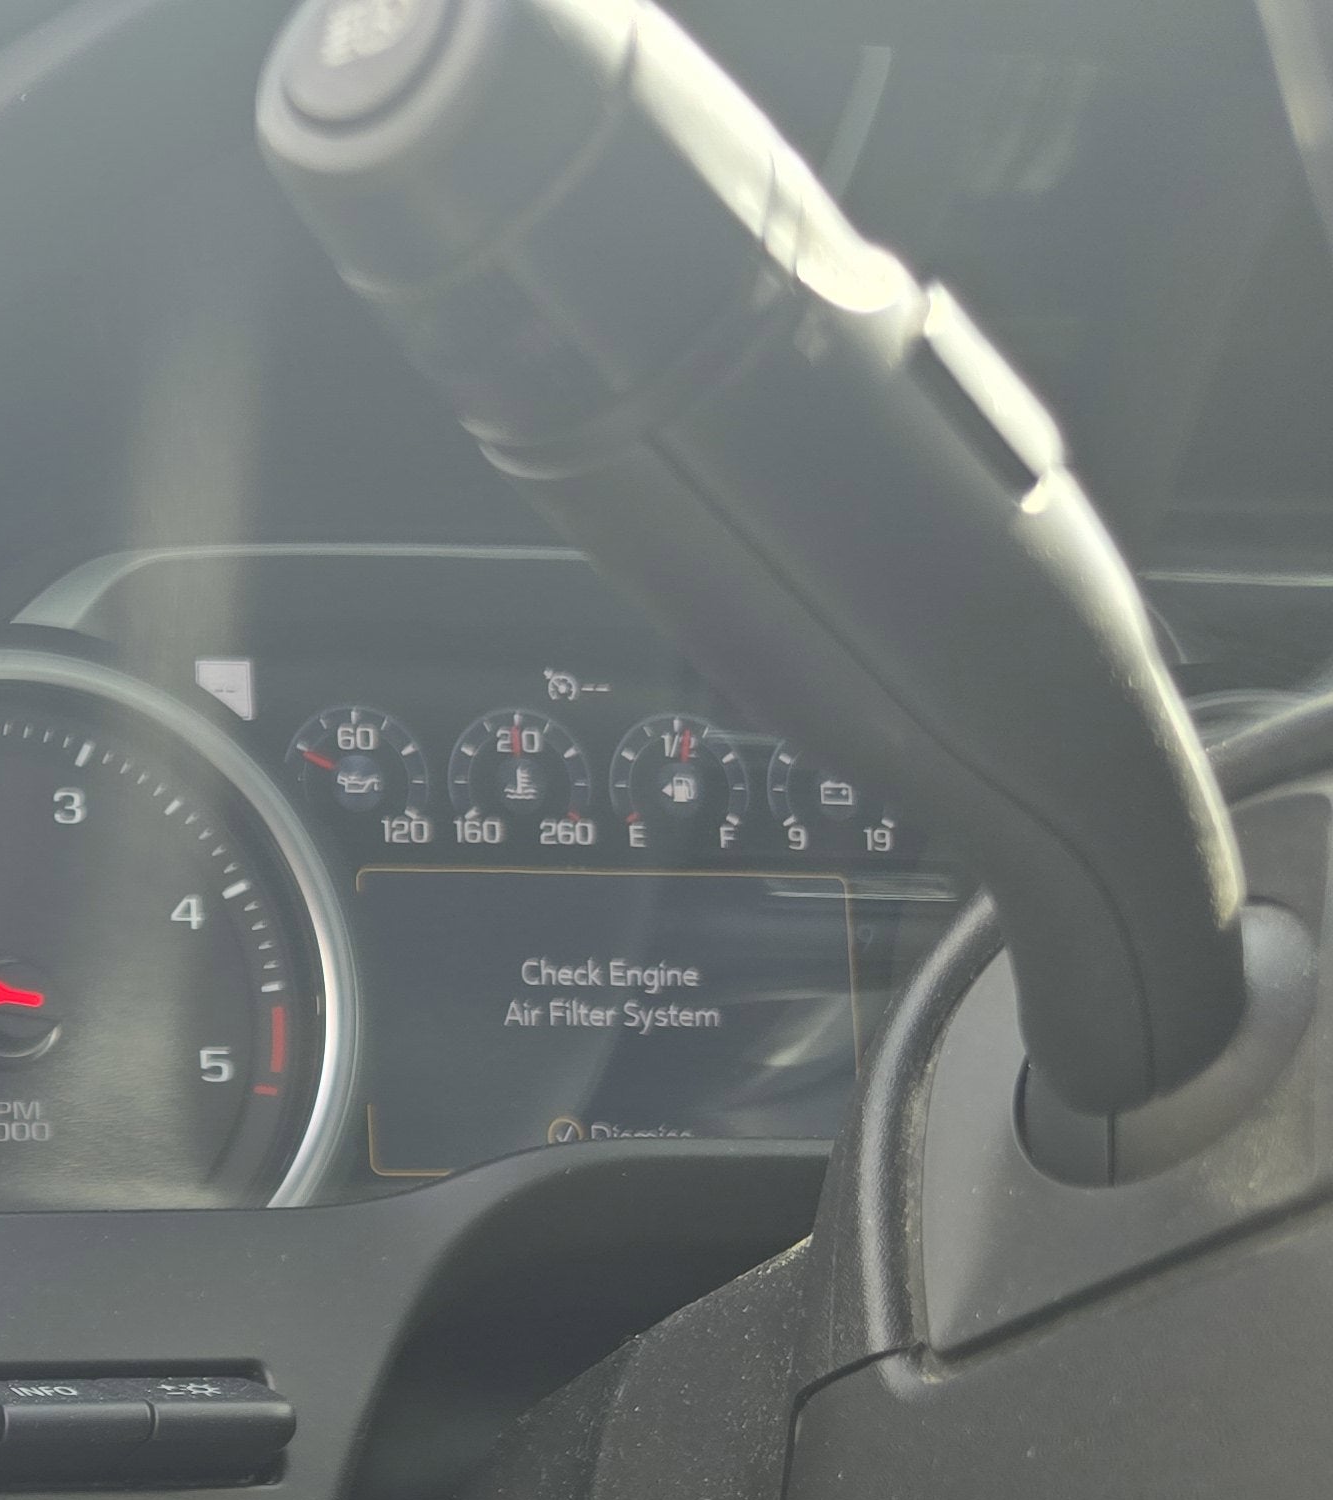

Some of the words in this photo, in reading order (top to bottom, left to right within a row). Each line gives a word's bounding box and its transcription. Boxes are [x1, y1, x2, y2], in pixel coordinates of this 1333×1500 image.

[337, 726, 375, 751] 60
[496, 729, 540, 753] 20
[53, 789, 86, 824] 3
[381, 818, 430, 843] 120
[453, 818, 503, 844] 160
[539, 820, 595, 846] 260
[628, 823, 647, 848] E
[718, 826, 735, 849] F
[787, 828, 807, 850] 9
[863, 829, 895, 852] 19
[169, 895, 204, 930] 4
[521, 957, 602, 987] Check
[609, 958, 700, 994] Engine
[503, 1000, 542, 1027] Air
[548, 999, 617, 1027] Filter
[623, 1000, 721, 1035] System
[199, 1047, 233, 1083] 5
[10, 1386, 79, 1398] INFO
